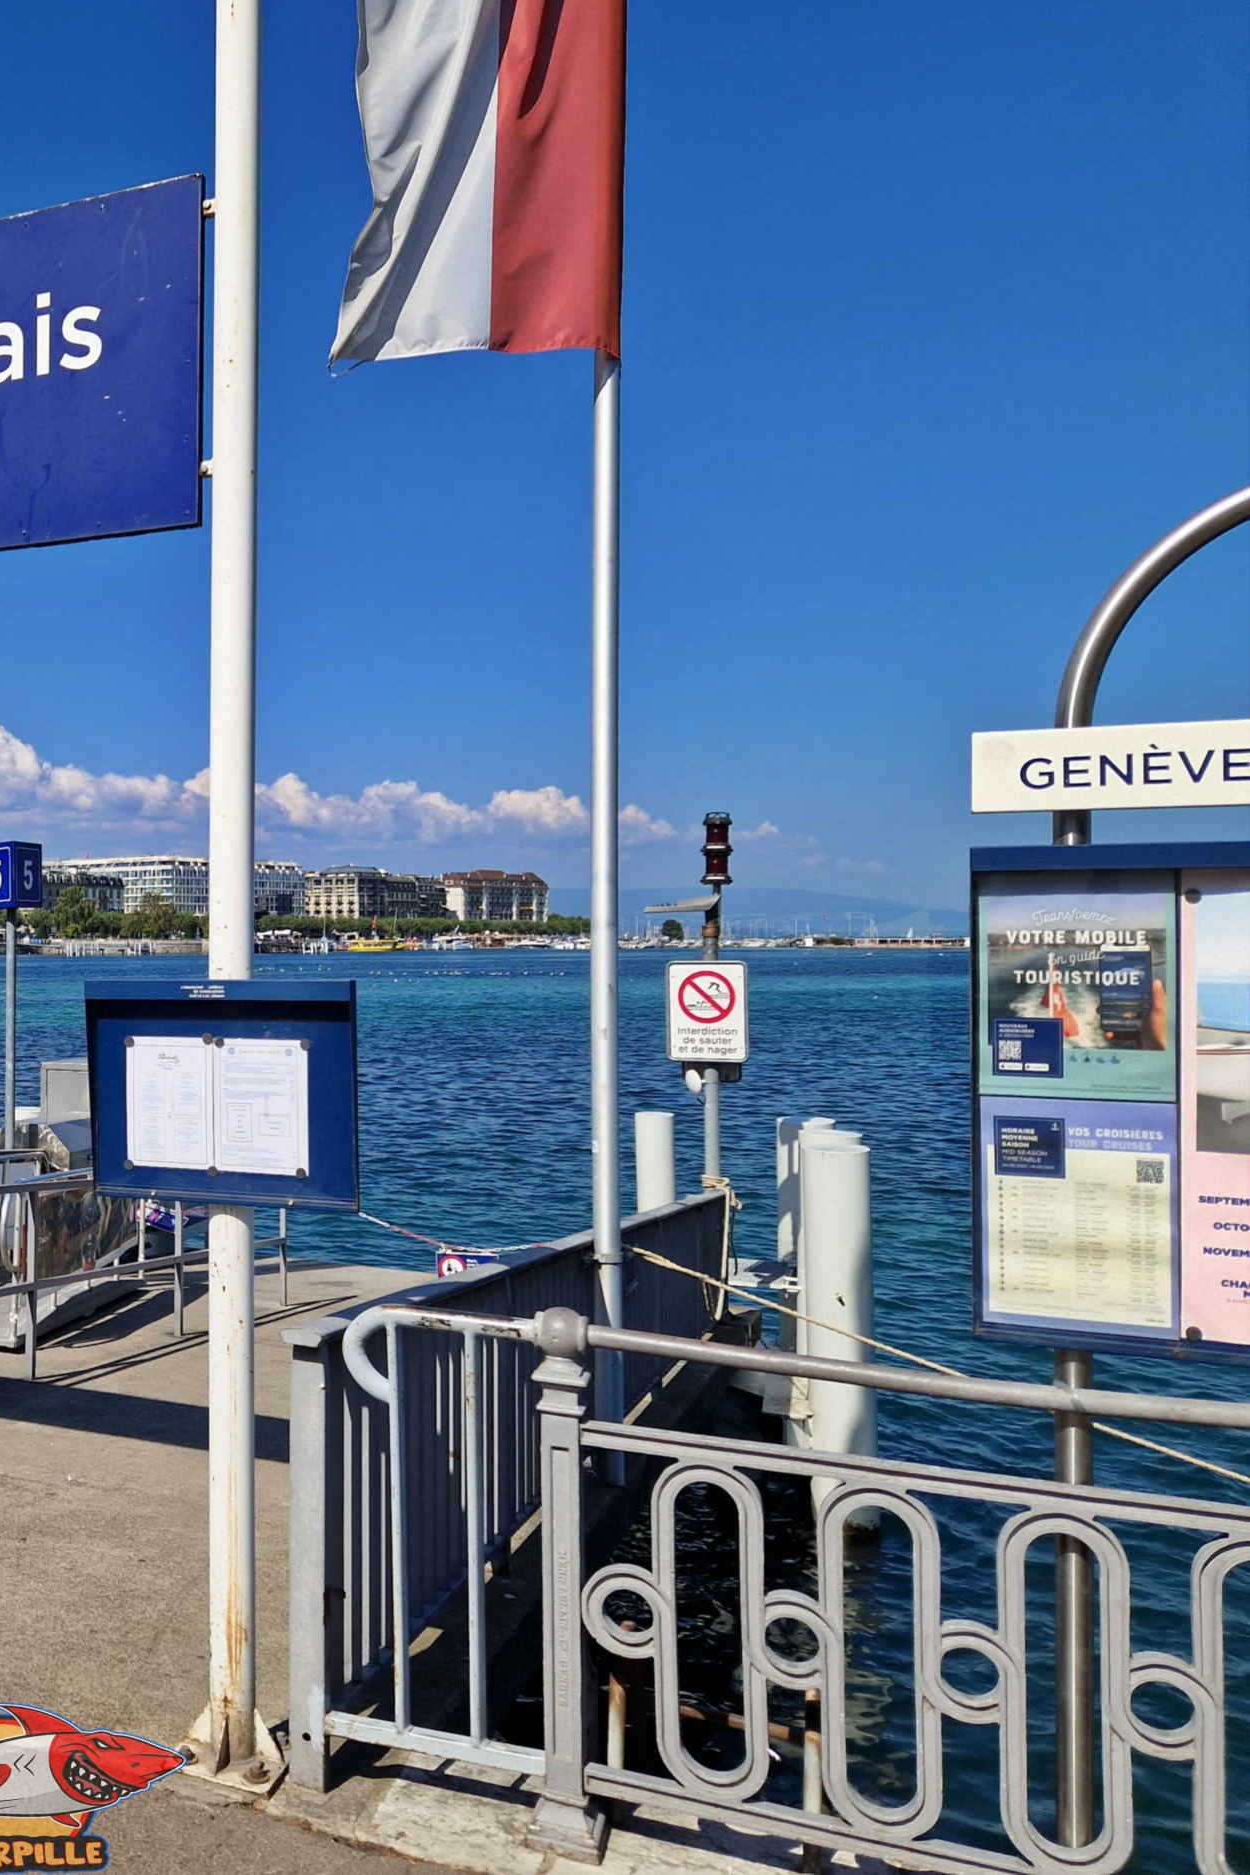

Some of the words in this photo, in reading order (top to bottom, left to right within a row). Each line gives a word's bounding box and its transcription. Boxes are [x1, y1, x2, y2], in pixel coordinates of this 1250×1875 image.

[1019, 743, 1250, 790] GENÈVE
[23, 860, 33, 890] 5
[1006, 929, 1066, 945] VOTRE
[1075, 929, 1147, 945] MOBILE
[1013, 970, 1140, 987] TOURISTIQUE
[677, 1027, 738, 1036] Interdiction
[691, 1046, 704, 1054] de
[706, 1047, 738, 1056] nager
[1068, 1127, 1091, 1138] VOS
[1069, 1138, 1098, 1149] YOUR
[1103, 1140, 1153, 1151] CRUISES
[1221, 1279, 1250, 1289] CHA
